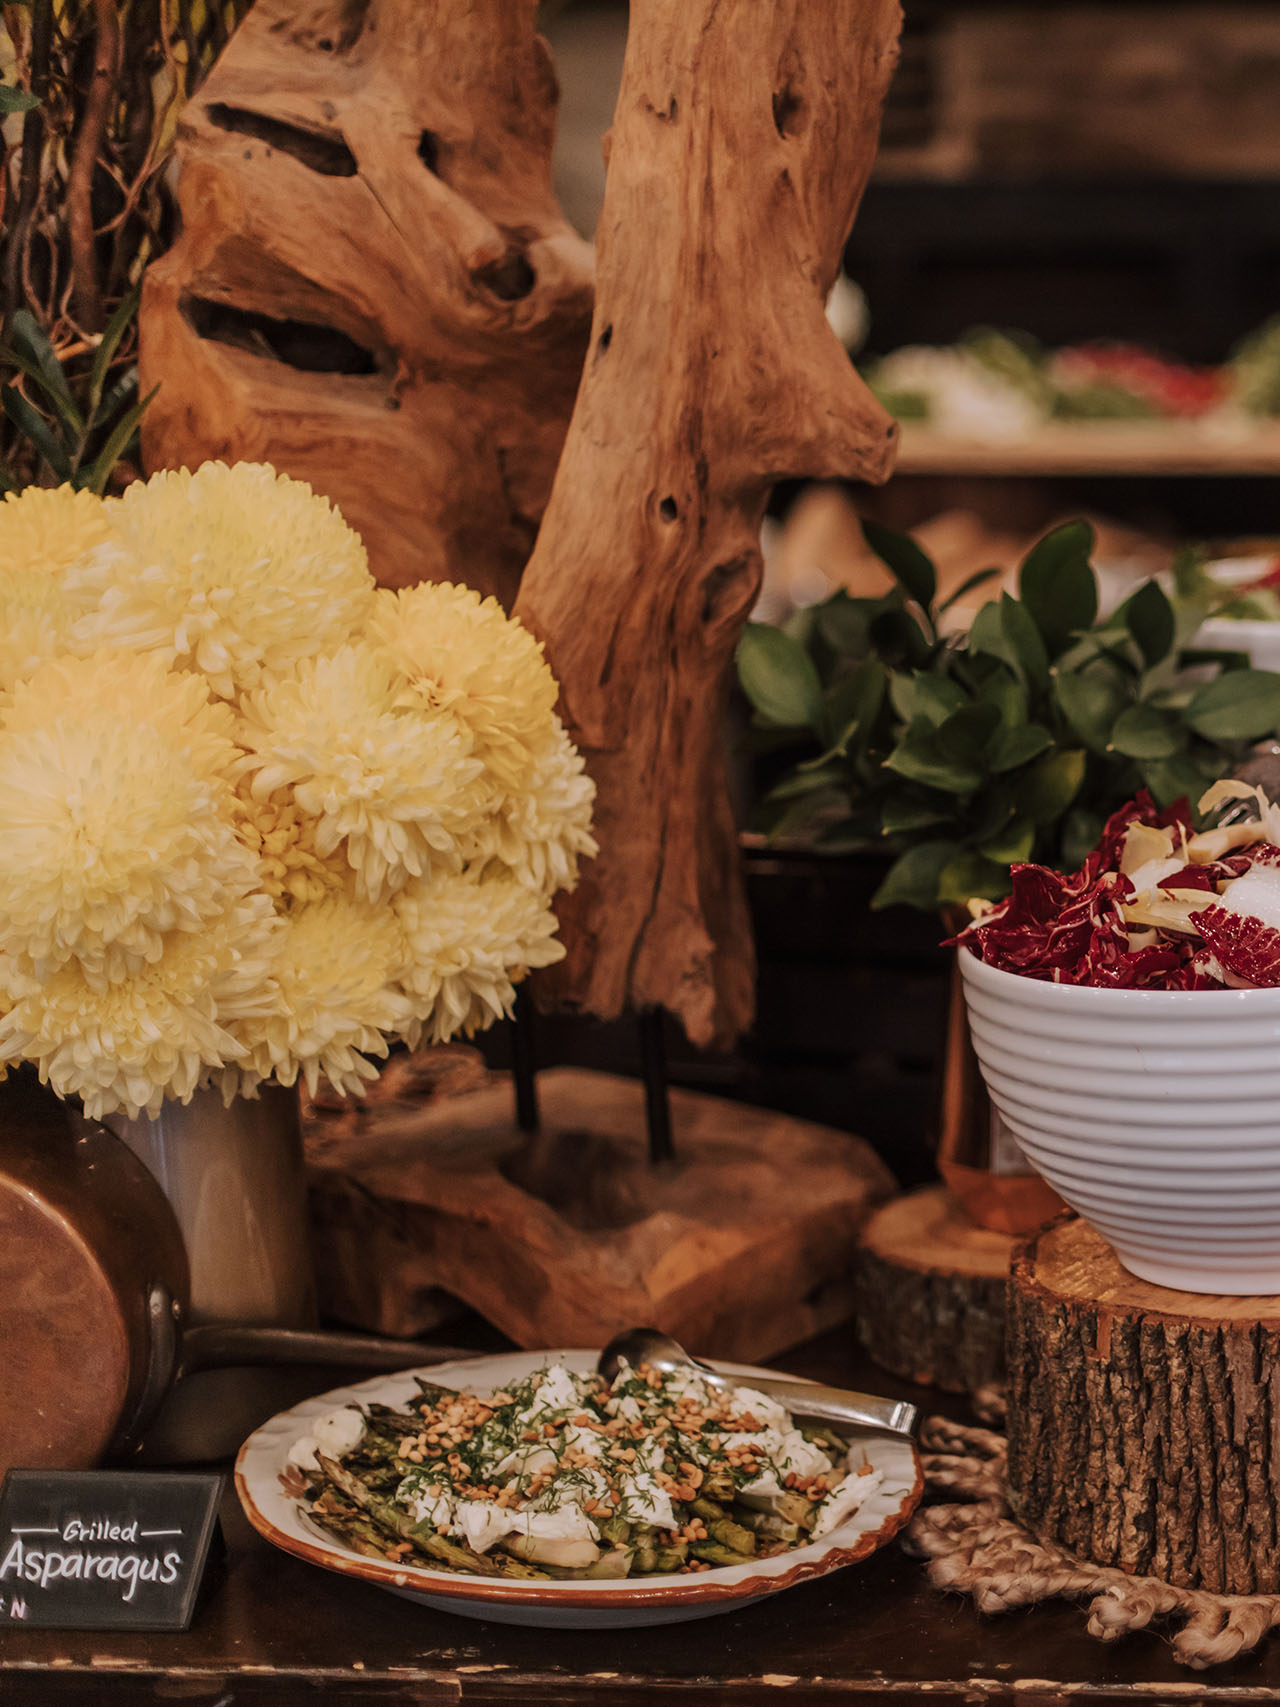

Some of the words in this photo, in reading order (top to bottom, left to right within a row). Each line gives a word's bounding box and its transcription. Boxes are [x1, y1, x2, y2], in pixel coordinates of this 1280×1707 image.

[62, 1520, 138, 1542] Grilled
[0, 1540, 181, 1601] Asparagus
[10, 1598, 26, 1618] N
